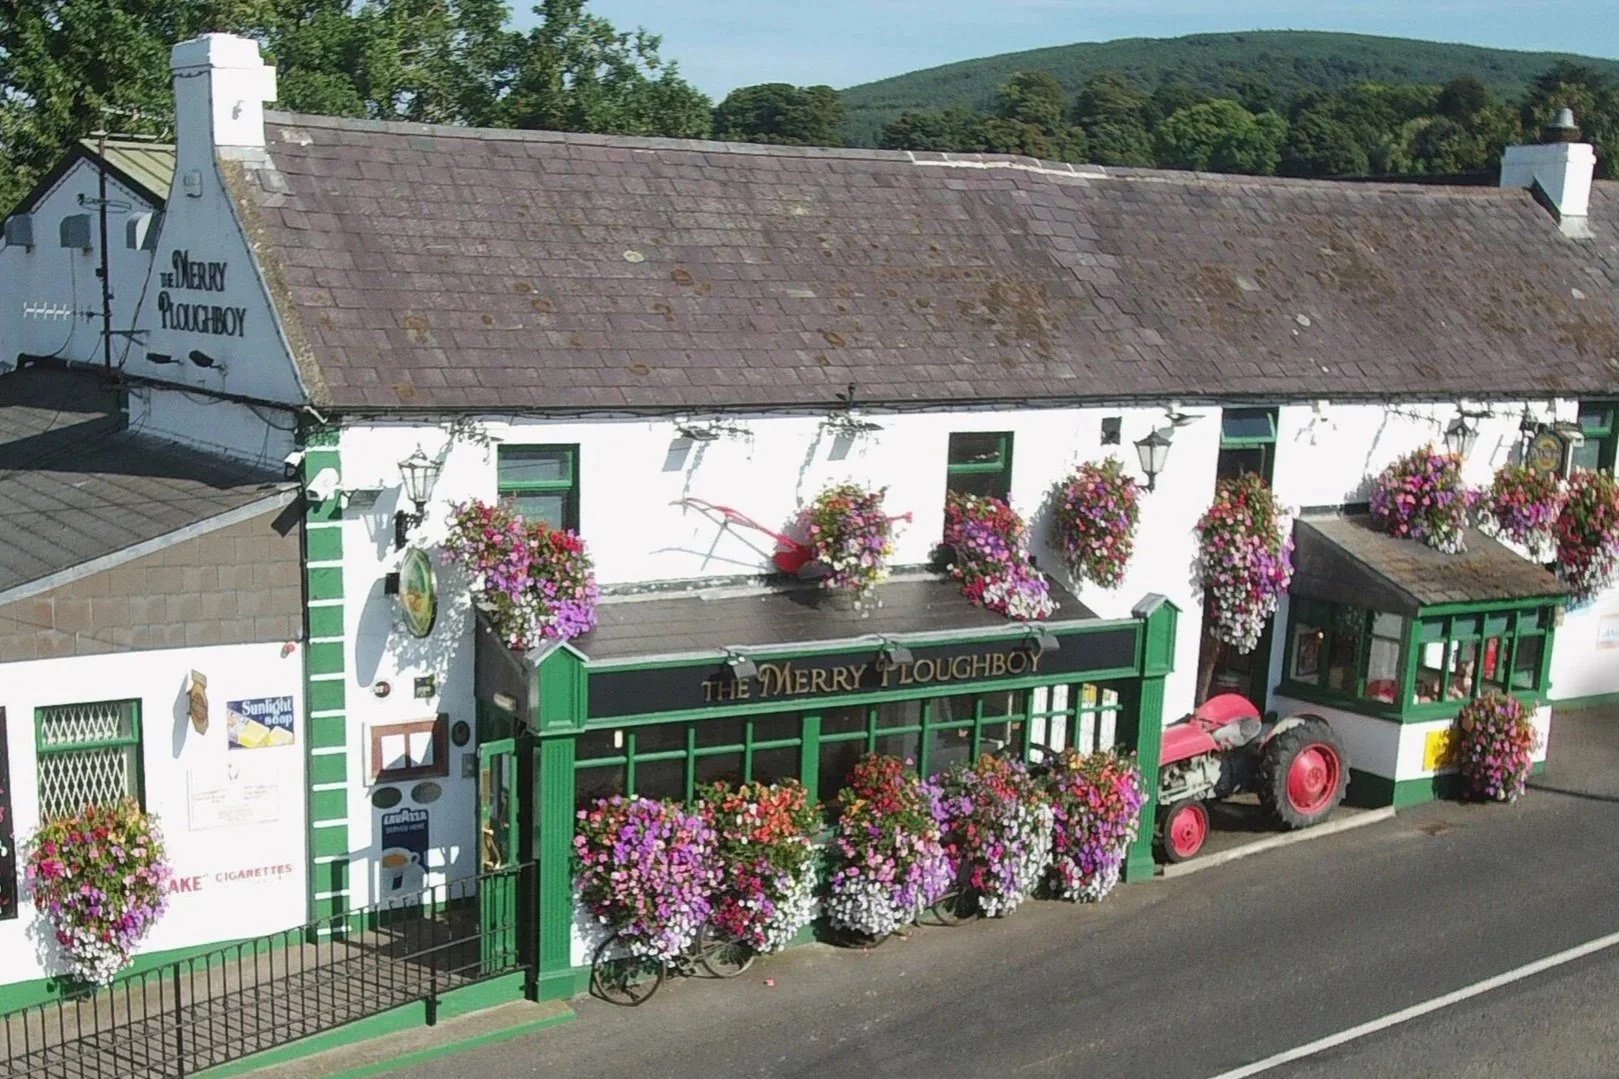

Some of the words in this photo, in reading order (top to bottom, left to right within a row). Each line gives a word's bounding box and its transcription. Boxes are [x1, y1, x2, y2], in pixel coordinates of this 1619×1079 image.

[159, 272, 174, 288] THE
[172, 249, 227, 292] MERRY
[158, 290, 247, 337] PLOUGHBOY
[701, 676, 750, 702] THE
[758, 661, 867, 698] MERRY
[876, 650, 1043, 687] PLOUGHBOY
[242, 698, 292, 717] Sunlight
[264, 714, 293, 727] soap
[215, 863, 293, 883] CIGARETTES
